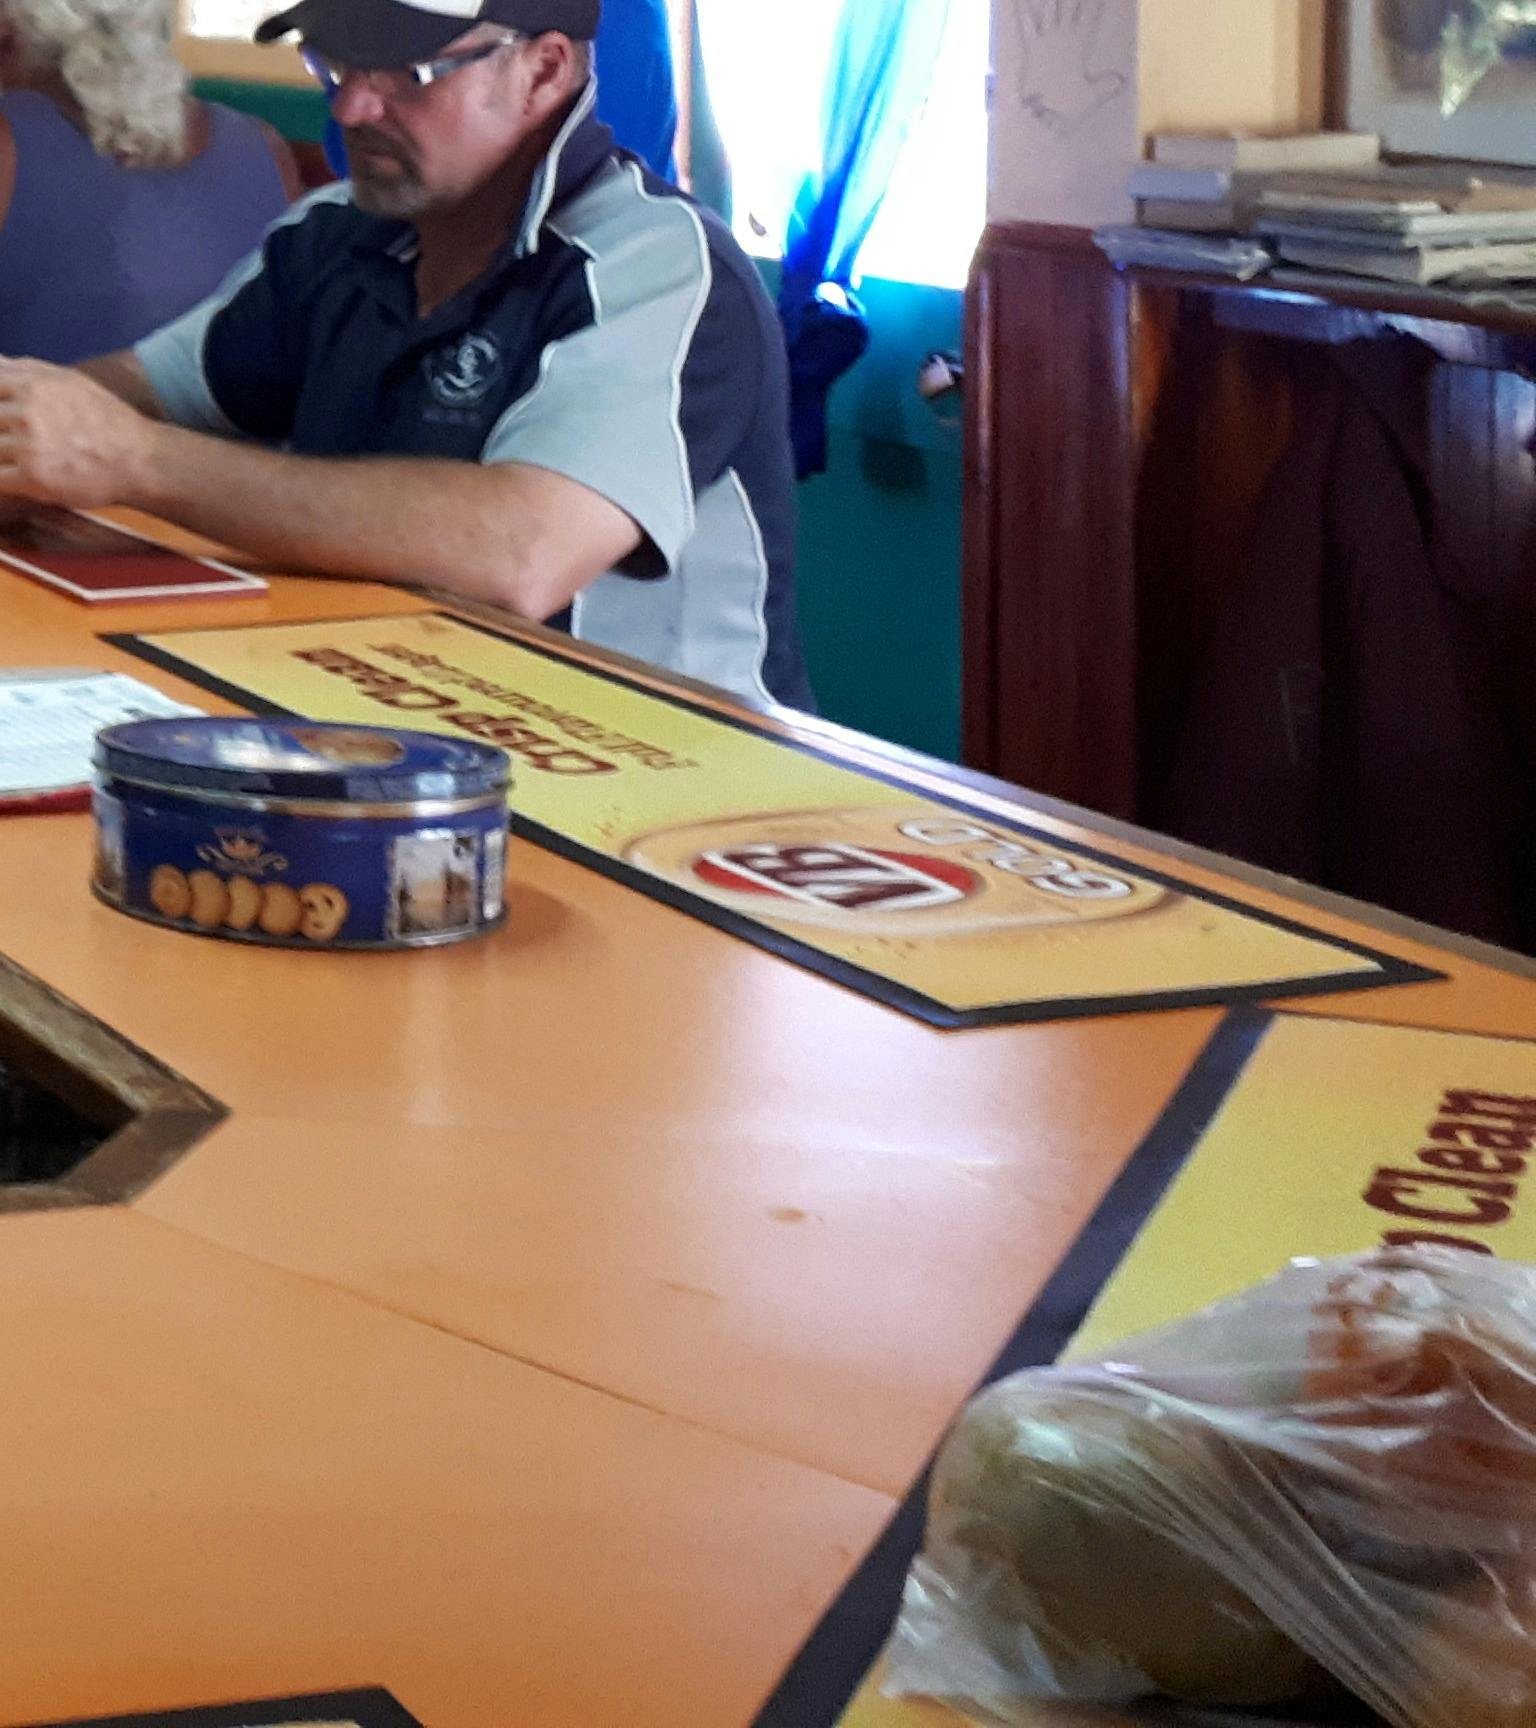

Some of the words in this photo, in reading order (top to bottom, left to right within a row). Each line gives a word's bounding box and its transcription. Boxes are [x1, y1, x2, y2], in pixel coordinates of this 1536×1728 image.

[290, 647, 461, 711] Clean
[437, 712, 620, 776] Crisp
[600, 731, 701, 771] Full
[723, 844, 938, 908] VB
[897, 816, 1135, 899] GOLD
[1362, 1087, 1536, 1228] Clean
